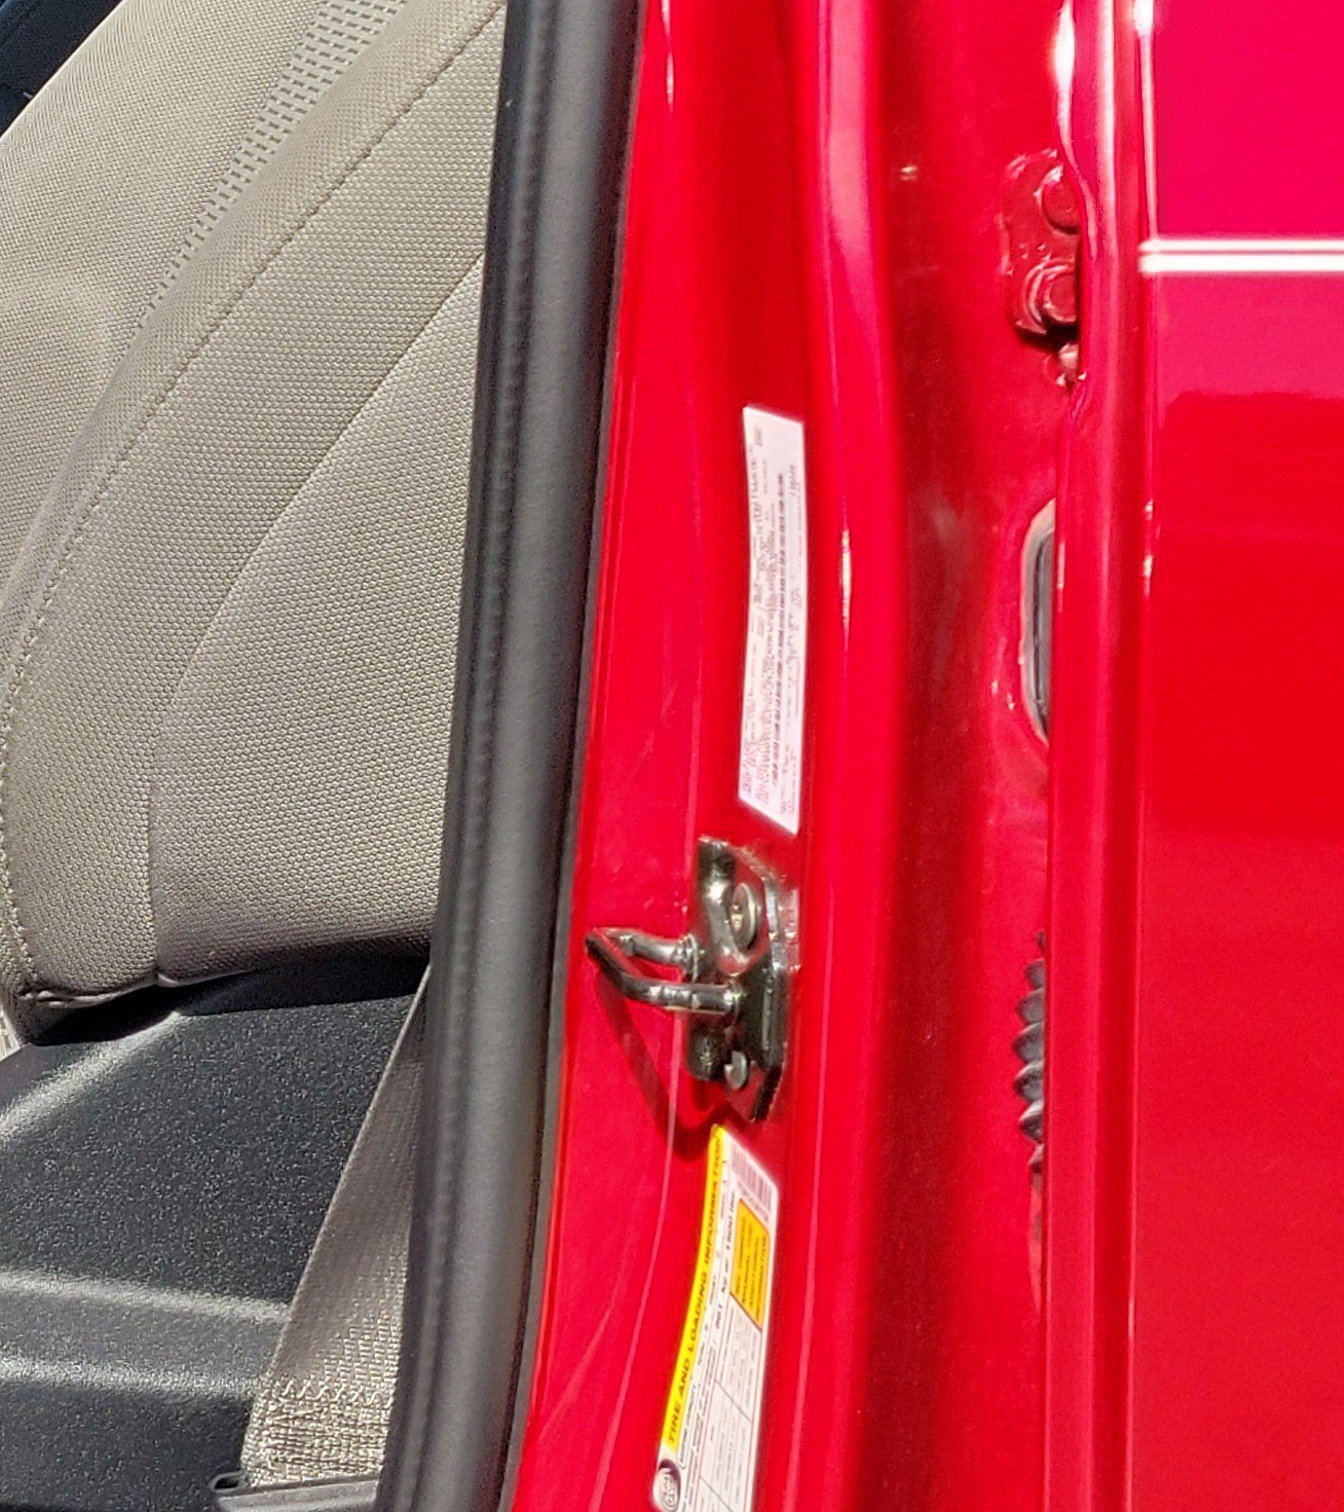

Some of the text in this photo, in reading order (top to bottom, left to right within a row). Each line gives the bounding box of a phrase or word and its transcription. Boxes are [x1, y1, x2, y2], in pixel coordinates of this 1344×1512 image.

[668, 1402, 681, 1442] TIRE
[679, 1358, 690, 1399] AND
[688, 1272, 708, 1352] LOADING
